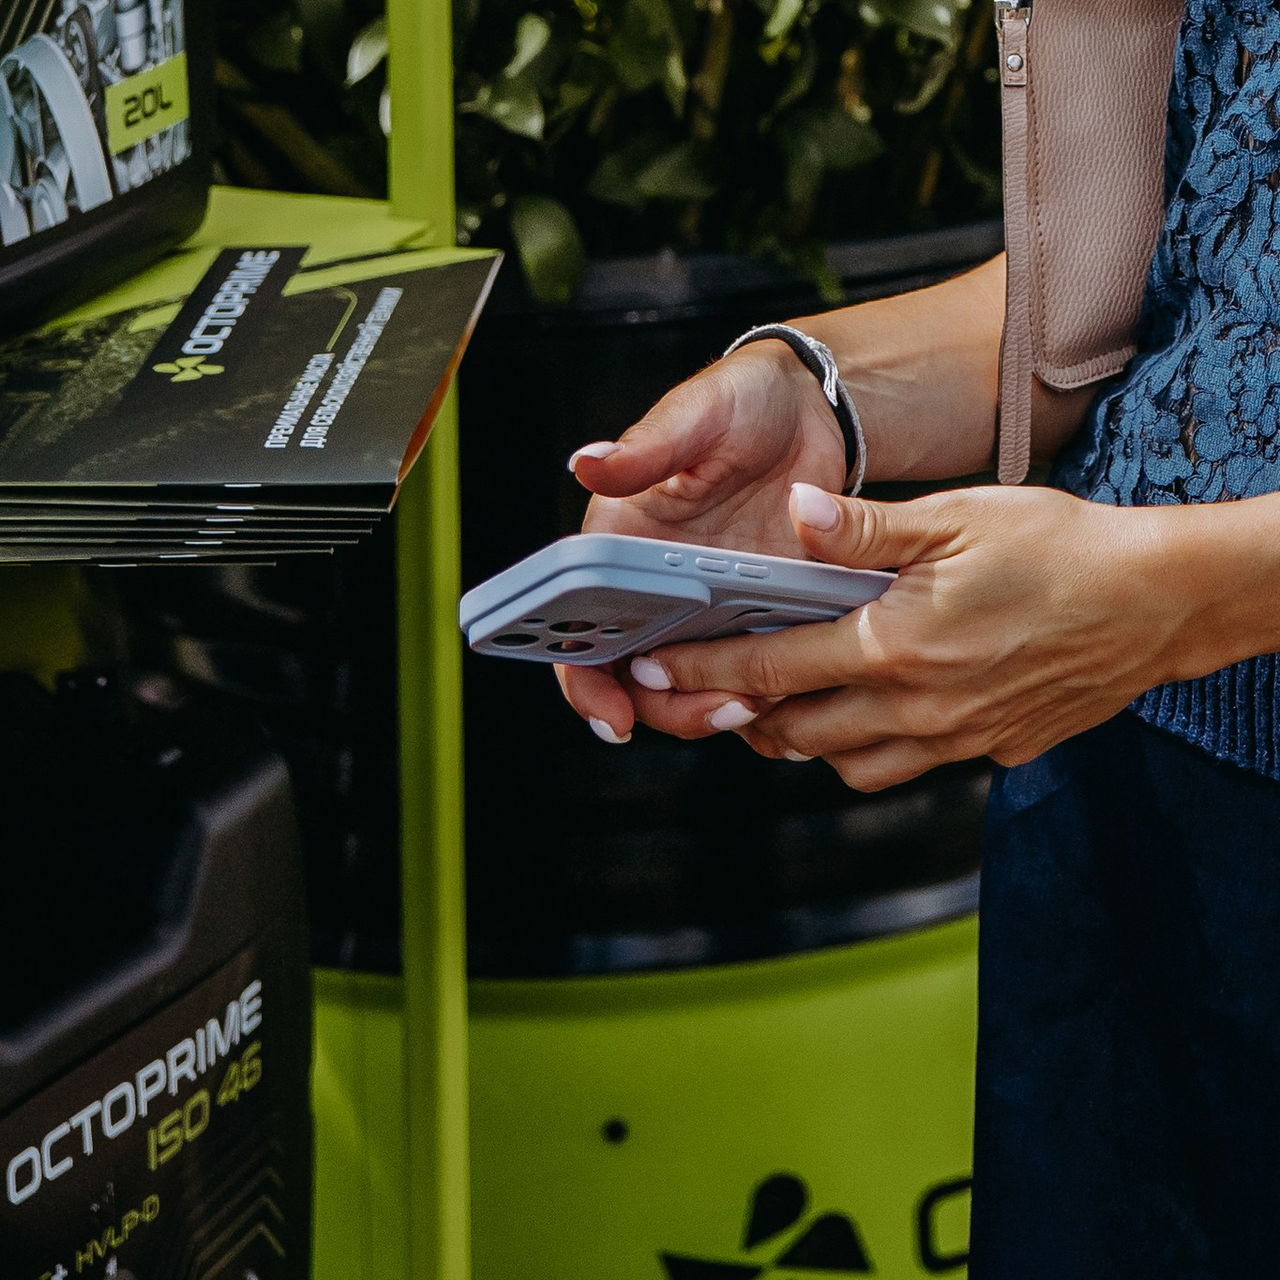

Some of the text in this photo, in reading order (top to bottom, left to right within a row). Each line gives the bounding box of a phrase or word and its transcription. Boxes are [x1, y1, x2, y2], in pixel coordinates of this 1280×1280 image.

[123, 81, 174, 127] 20L
[181, 250, 281, 355] OCTOPRIME
[6, 979, 262, 1205] OCTOPRIME
[147, 1041, 262, 1172] ISO 46
